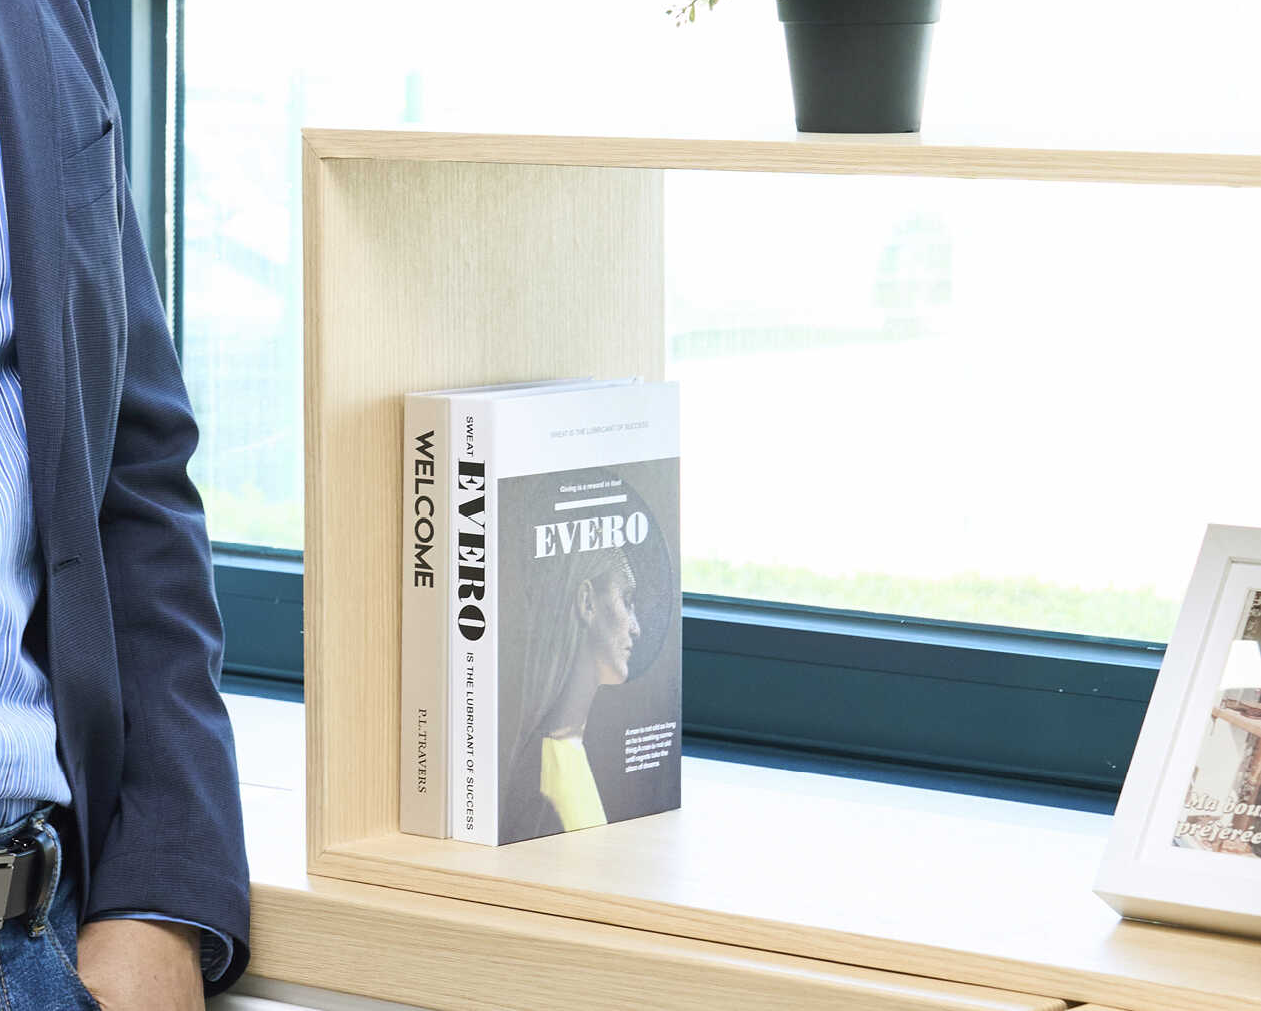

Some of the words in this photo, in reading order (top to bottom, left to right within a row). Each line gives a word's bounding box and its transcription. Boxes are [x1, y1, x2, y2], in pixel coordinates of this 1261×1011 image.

[466, 415, 474, 457] SWEAT
[414, 430, 435, 588] WELCOME
[458, 459, 486, 641] EVERO
[534, 511, 649, 559] EVERO
[466, 652, 474, 663] IS
[466, 665, 474, 688] THE
[466, 691, 474, 756] LUBRICANT
[466, 759, 474, 774] OF
[466, 776, 474, 831] SUCCESS
[1223, 794, 1261, 817] bou
